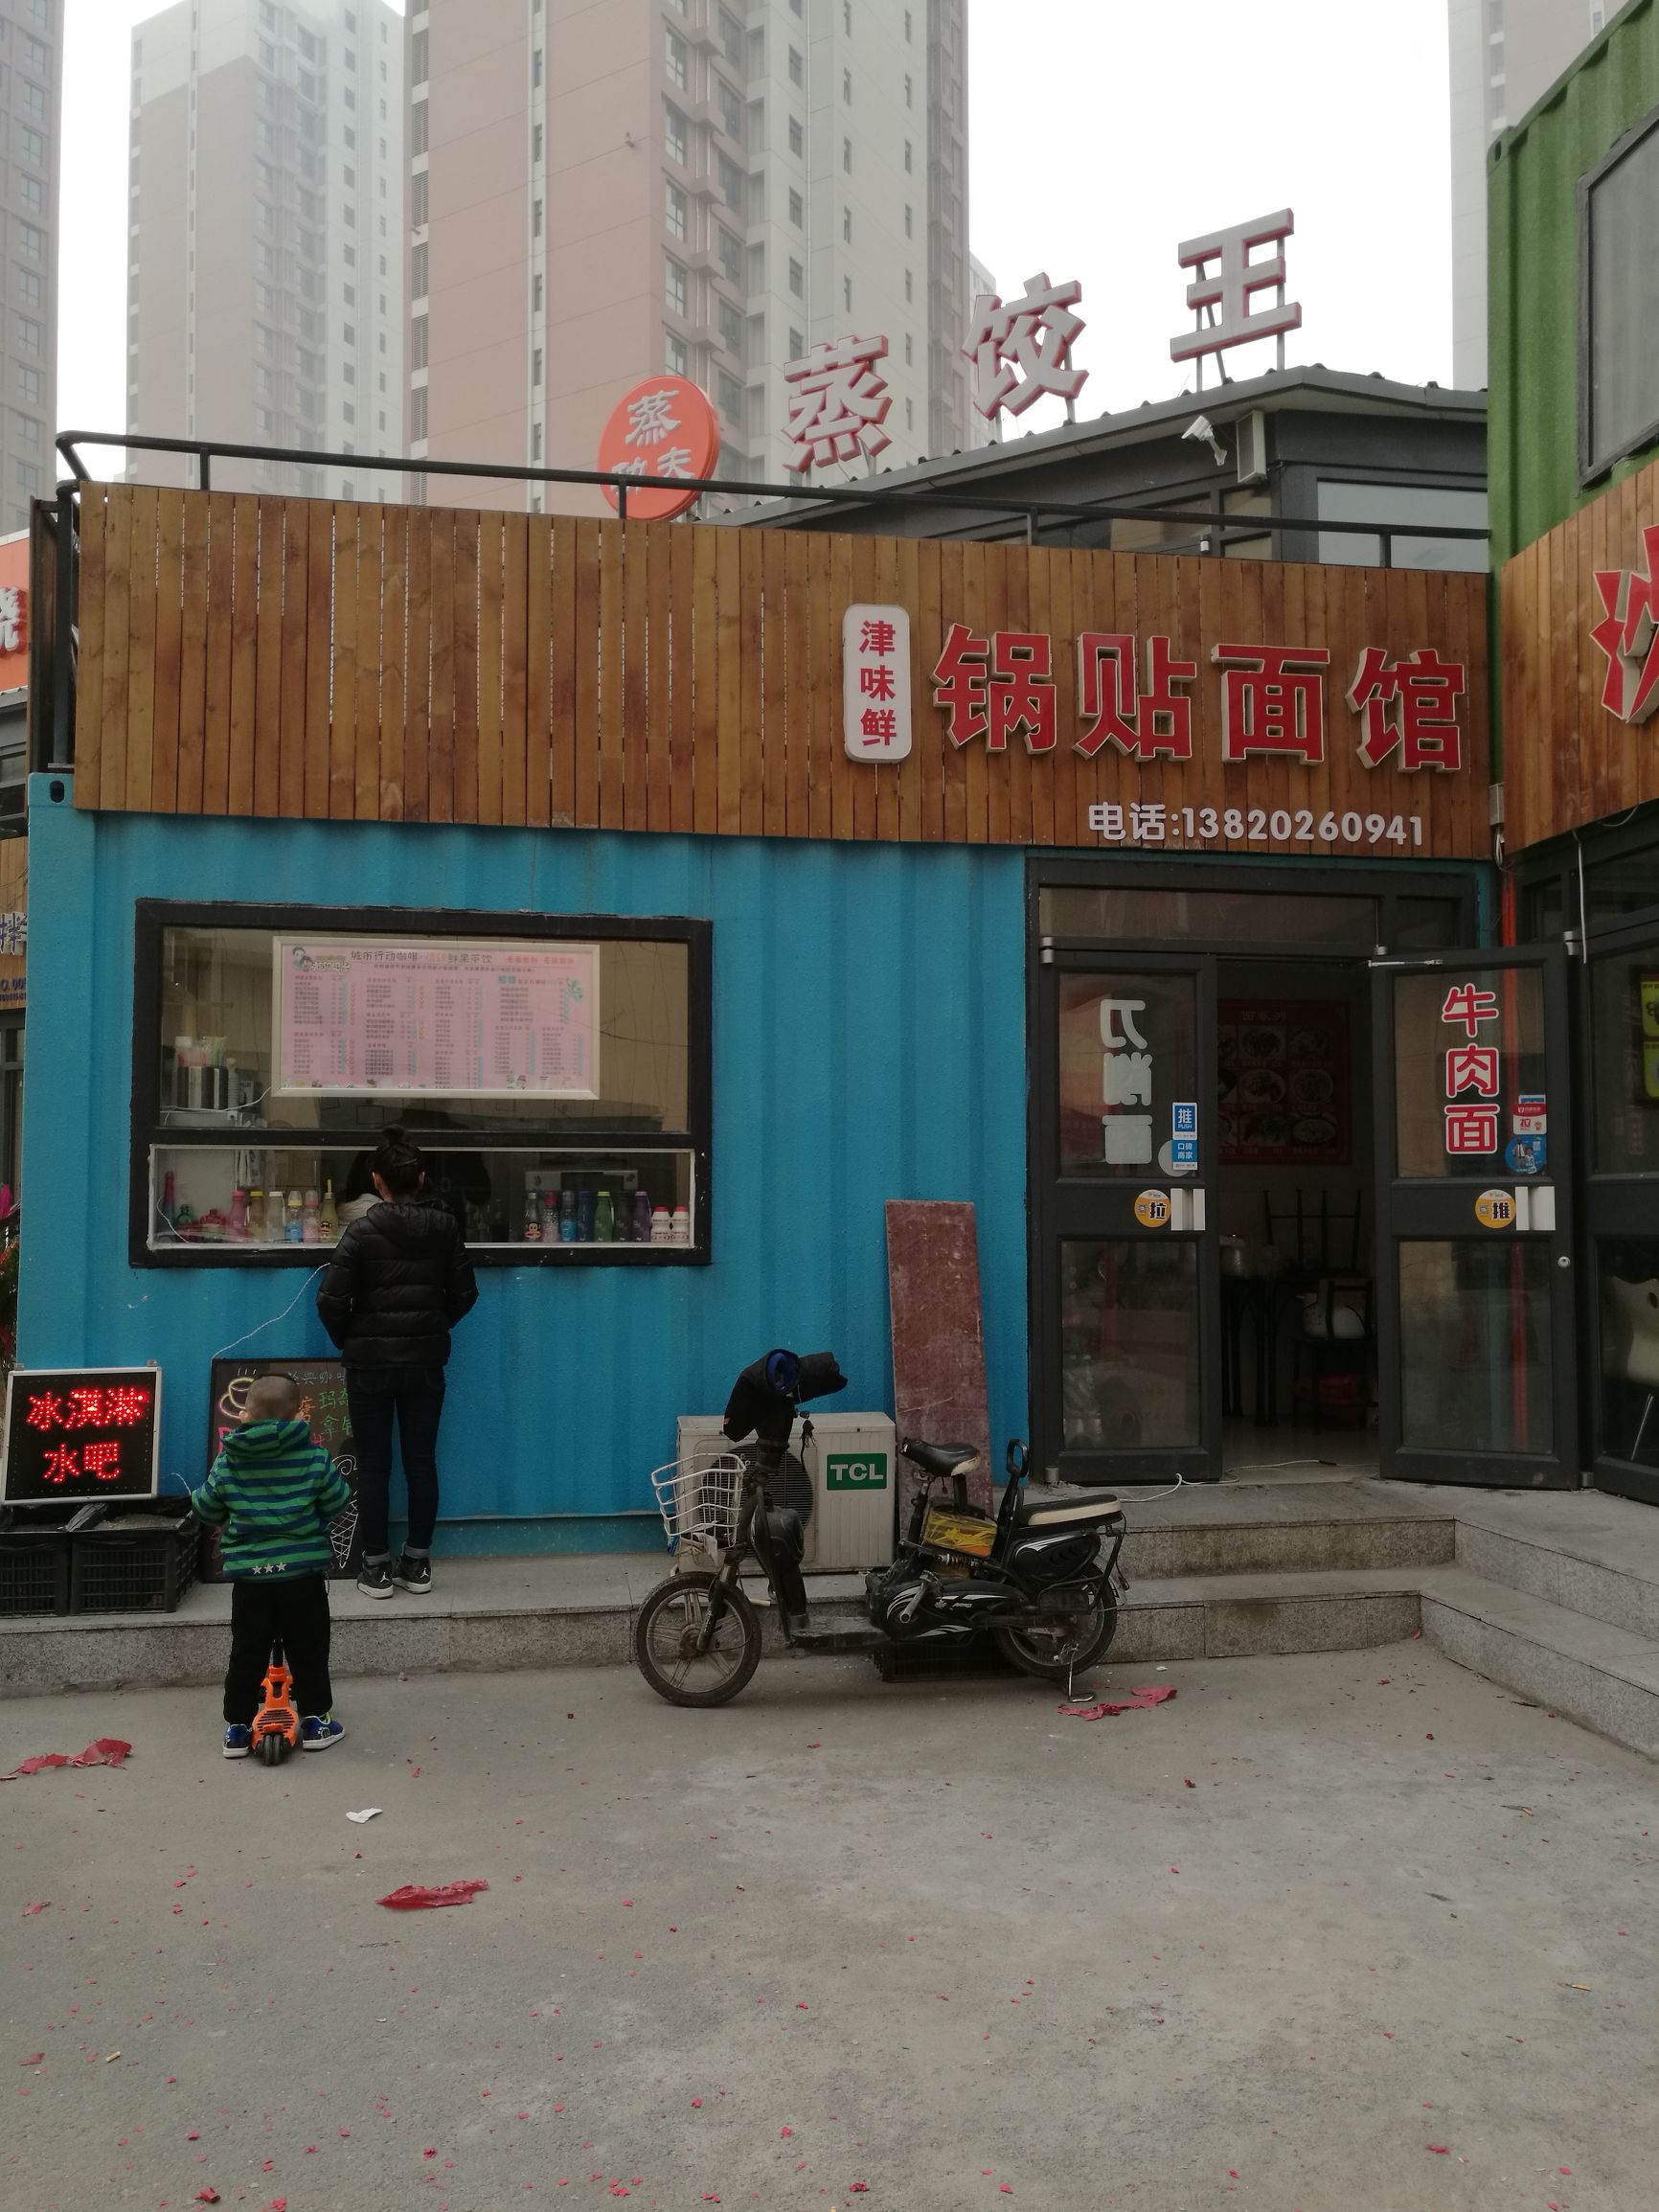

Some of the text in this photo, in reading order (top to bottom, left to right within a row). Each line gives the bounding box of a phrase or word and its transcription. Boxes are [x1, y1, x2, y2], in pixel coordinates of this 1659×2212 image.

[784, 208, 1302, 472] 蒸饺王
[625, 390, 683, 446] 蒸
[859, 620, 898, 747] 津味鲜
[933, 624, 1465, 772] 锅贴面馆
[1088, 803, 1423, 847] 电话:13820260941
[1442, 982, 1500, 1155] 牛肉面
[1178, 1108, 1193, 1124] 推
[1149, 1201, 1166, 1220] 拉
[1492, 1202, 1511, 1220] 推
[26, 1386, 148, 1431] 冰淇淋
[42, 1441, 122, 1484] 水吧
[830, 1463, 884, 1482] TCL
